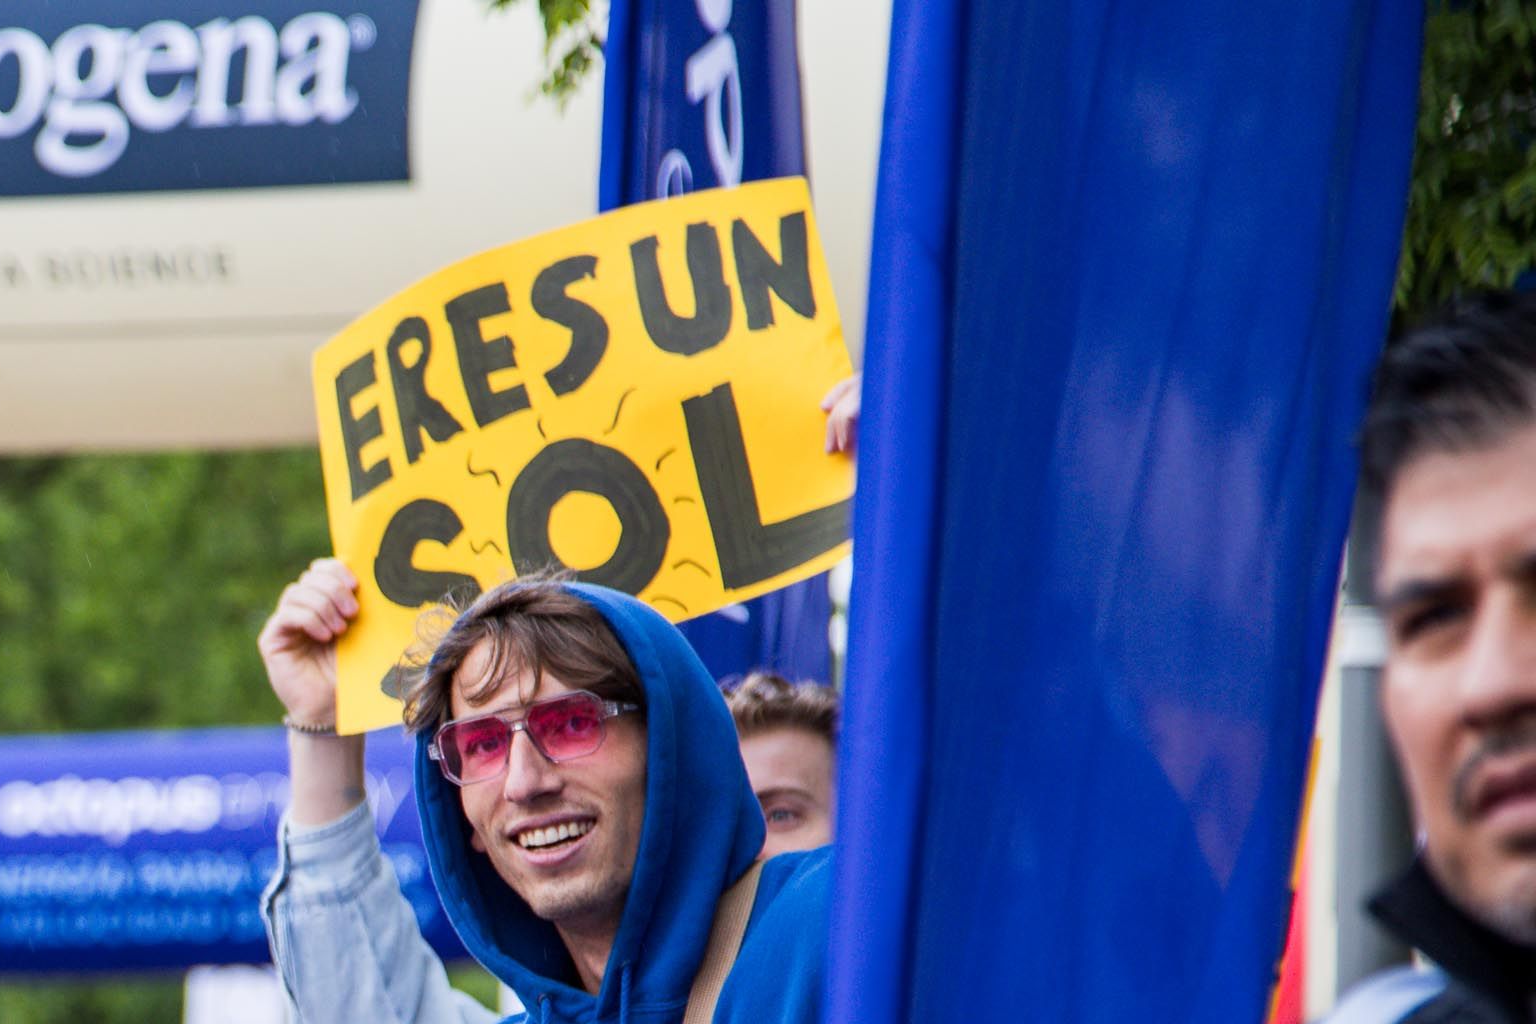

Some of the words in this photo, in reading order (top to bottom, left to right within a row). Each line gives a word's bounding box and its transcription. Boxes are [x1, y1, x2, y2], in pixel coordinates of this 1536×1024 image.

[43, 246, 237, 287] SCIENCE
[334, 254, 611, 503] ERES
[628, 210, 818, 357] UN
[373, 380, 856, 690] SOL
